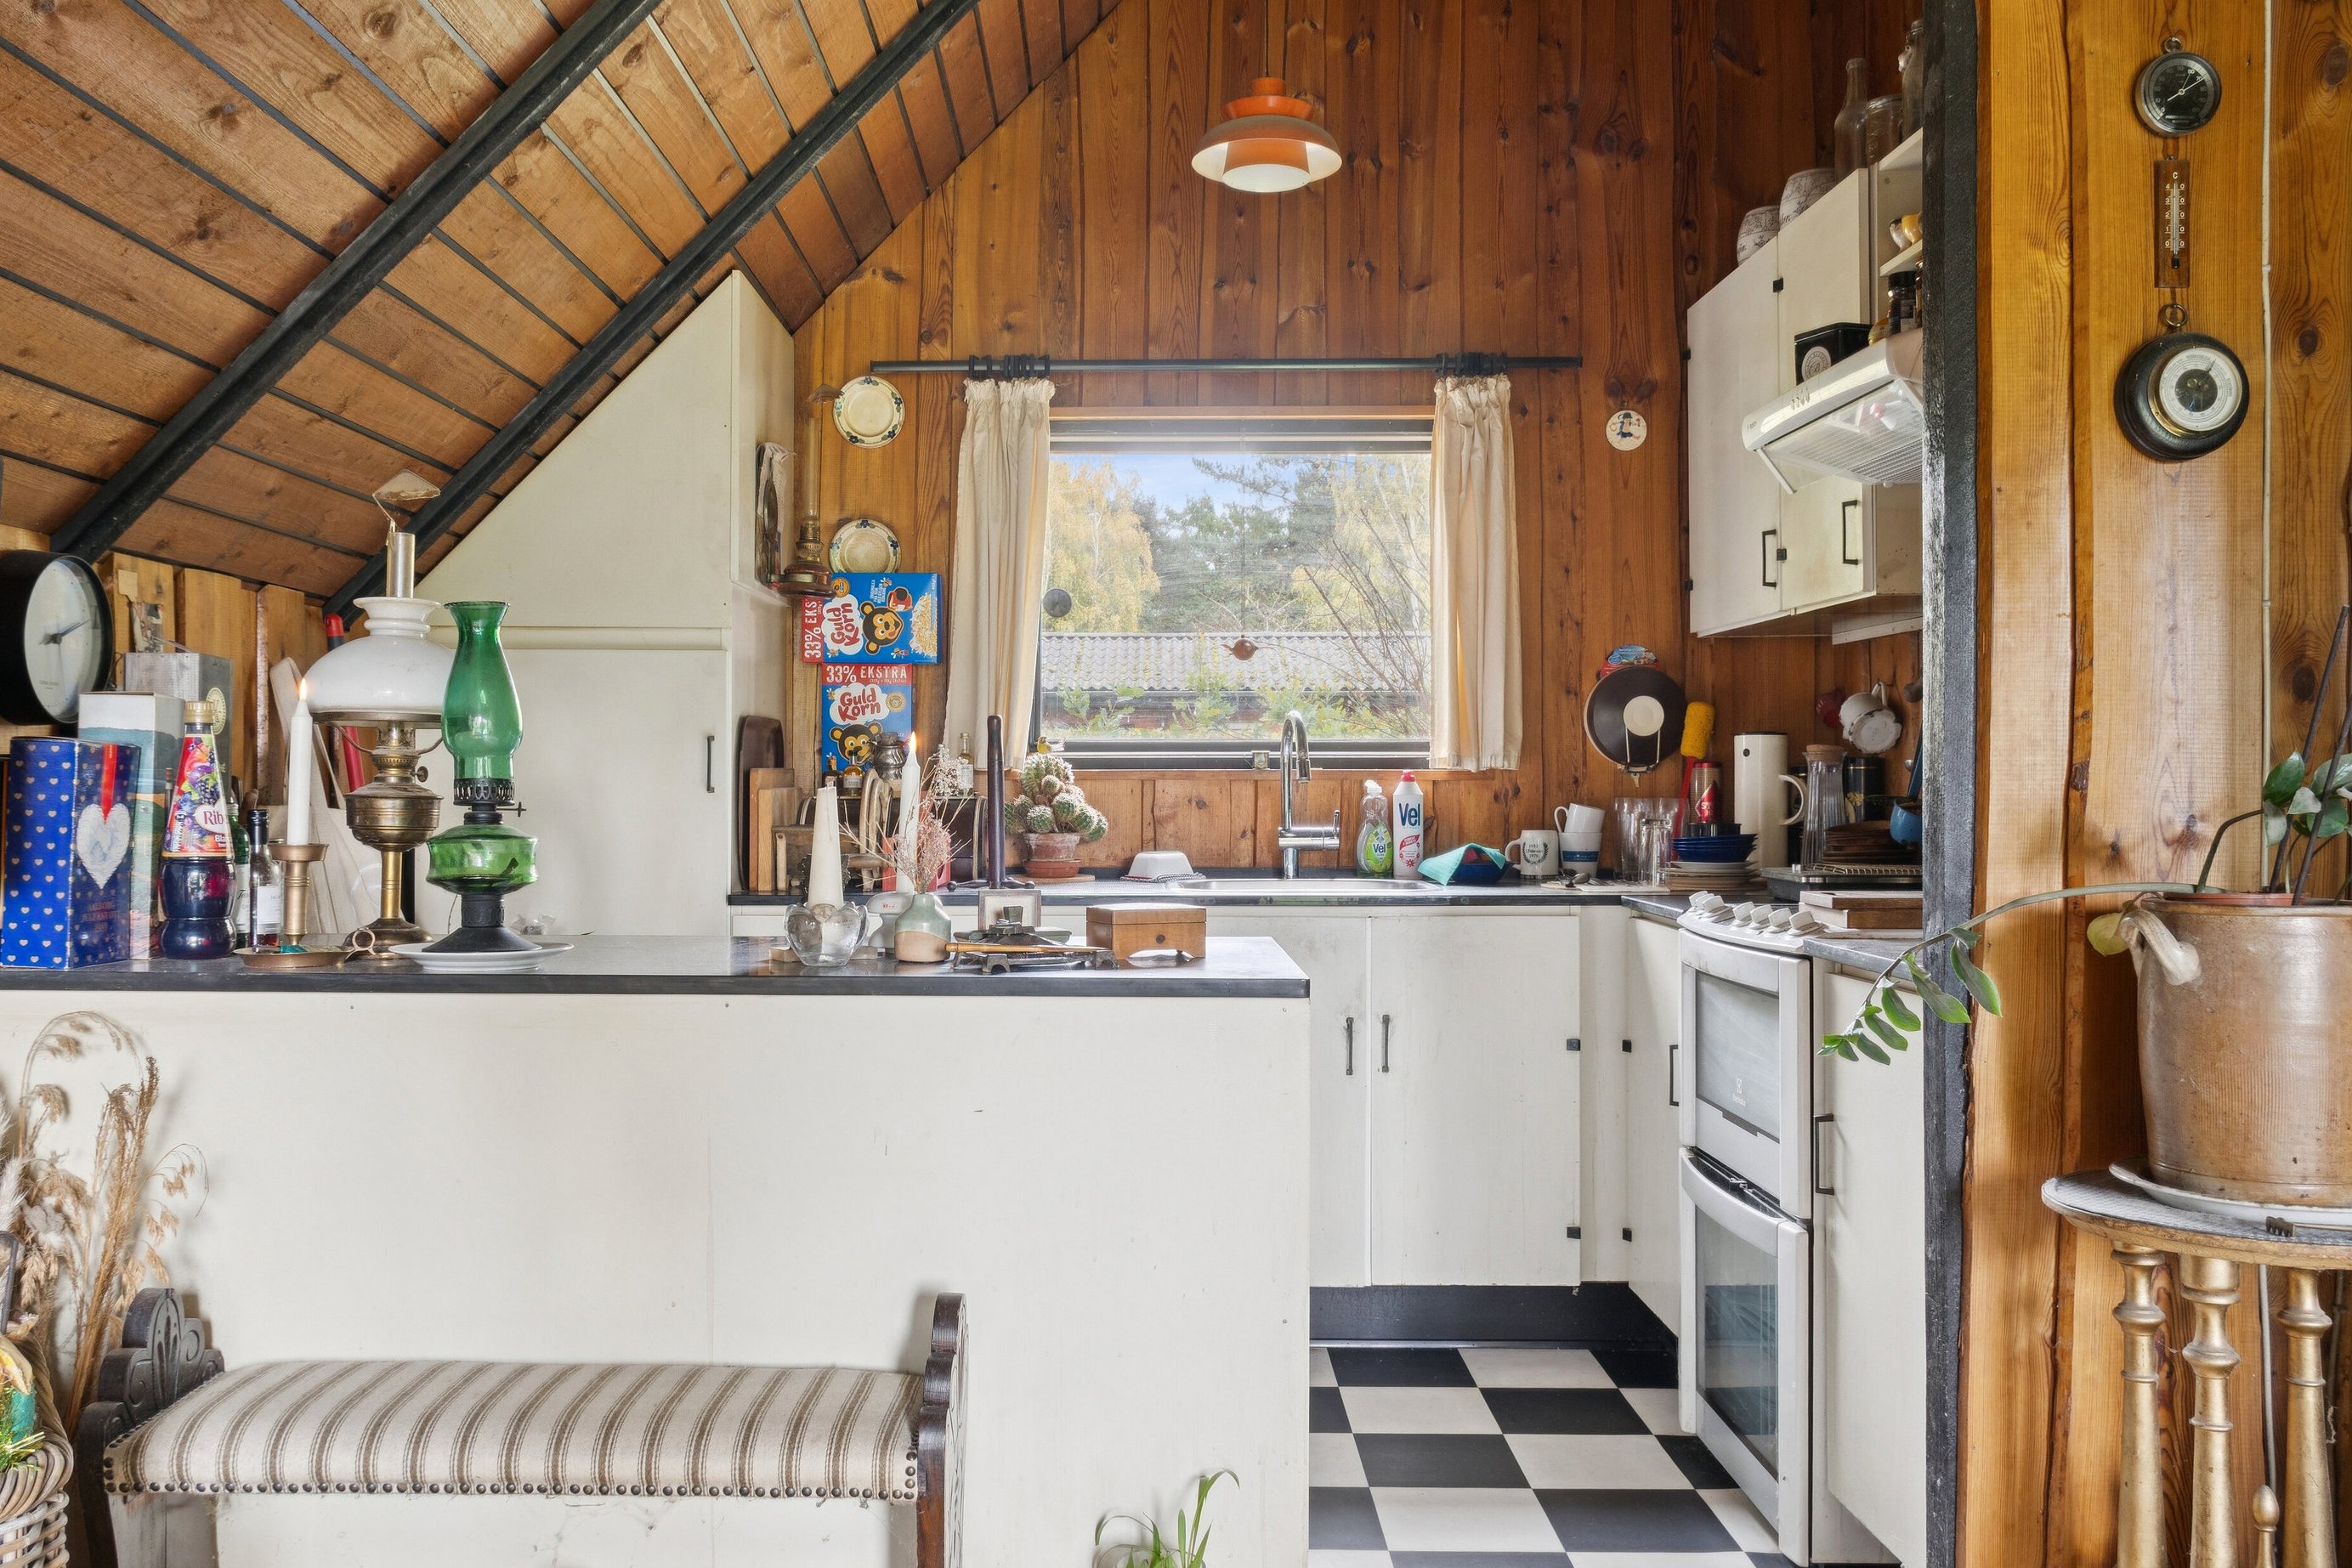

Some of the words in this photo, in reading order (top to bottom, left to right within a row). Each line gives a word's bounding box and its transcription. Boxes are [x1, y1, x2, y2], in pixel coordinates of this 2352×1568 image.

[804, 598, 817, 624] EKS
[826, 607, 846, 644] Guld
[841, 603, 860, 647] Korn
[804, 627, 821, 659] 33%
[826, 665, 857, 682] 33%
[860, 665, 907, 679] EKSTRA
[840, 687, 876, 707] Guld
[837, 702, 881, 722] Korn
[1398, 802, 1420, 826] Vel
[1373, 843, 1386, 853] Vel
